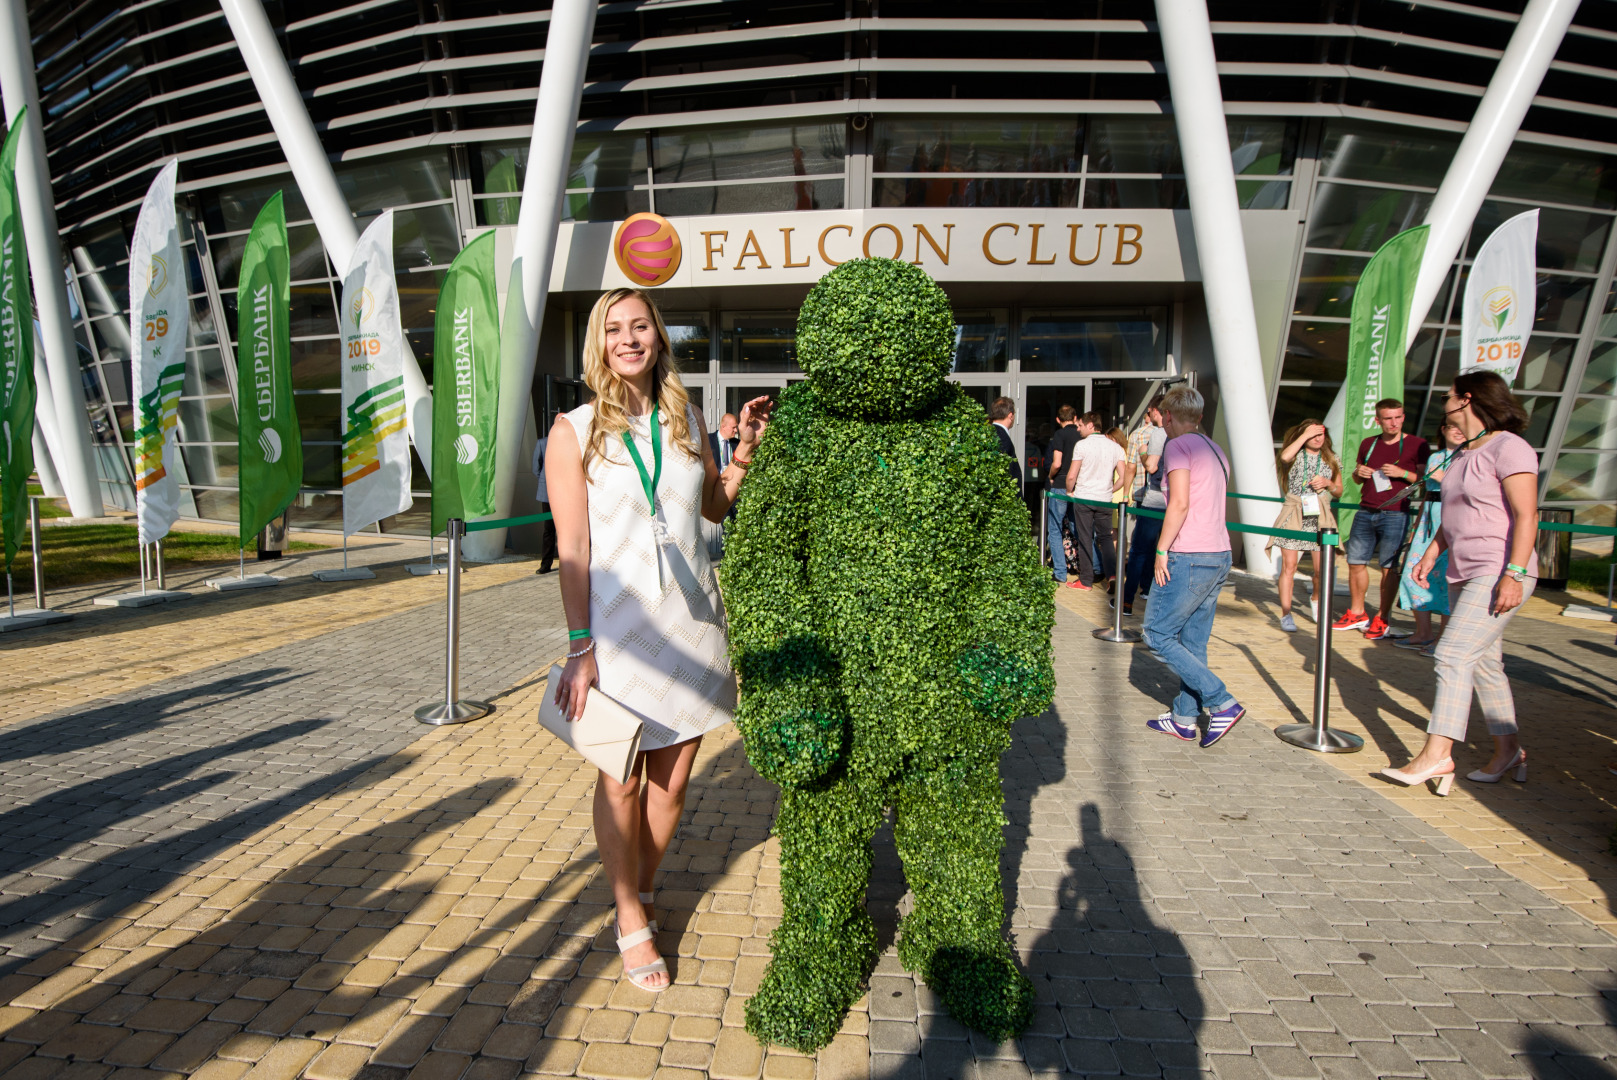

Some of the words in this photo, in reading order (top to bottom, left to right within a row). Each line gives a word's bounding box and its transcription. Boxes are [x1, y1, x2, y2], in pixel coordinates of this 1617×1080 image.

[700, 223, 955, 271] FALCON
[982, 222, 1143, 266] CLUB
[253, 284, 272, 422] СБЕРБАНК
[348, 338, 381, 359] 2019
[351, 362, 376, 373] МИНСК
[454, 307, 472, 427] SBERBANK
[1362, 304, 1388, 430] SBERBANK
[1476, 341, 1522, 363] 2019
